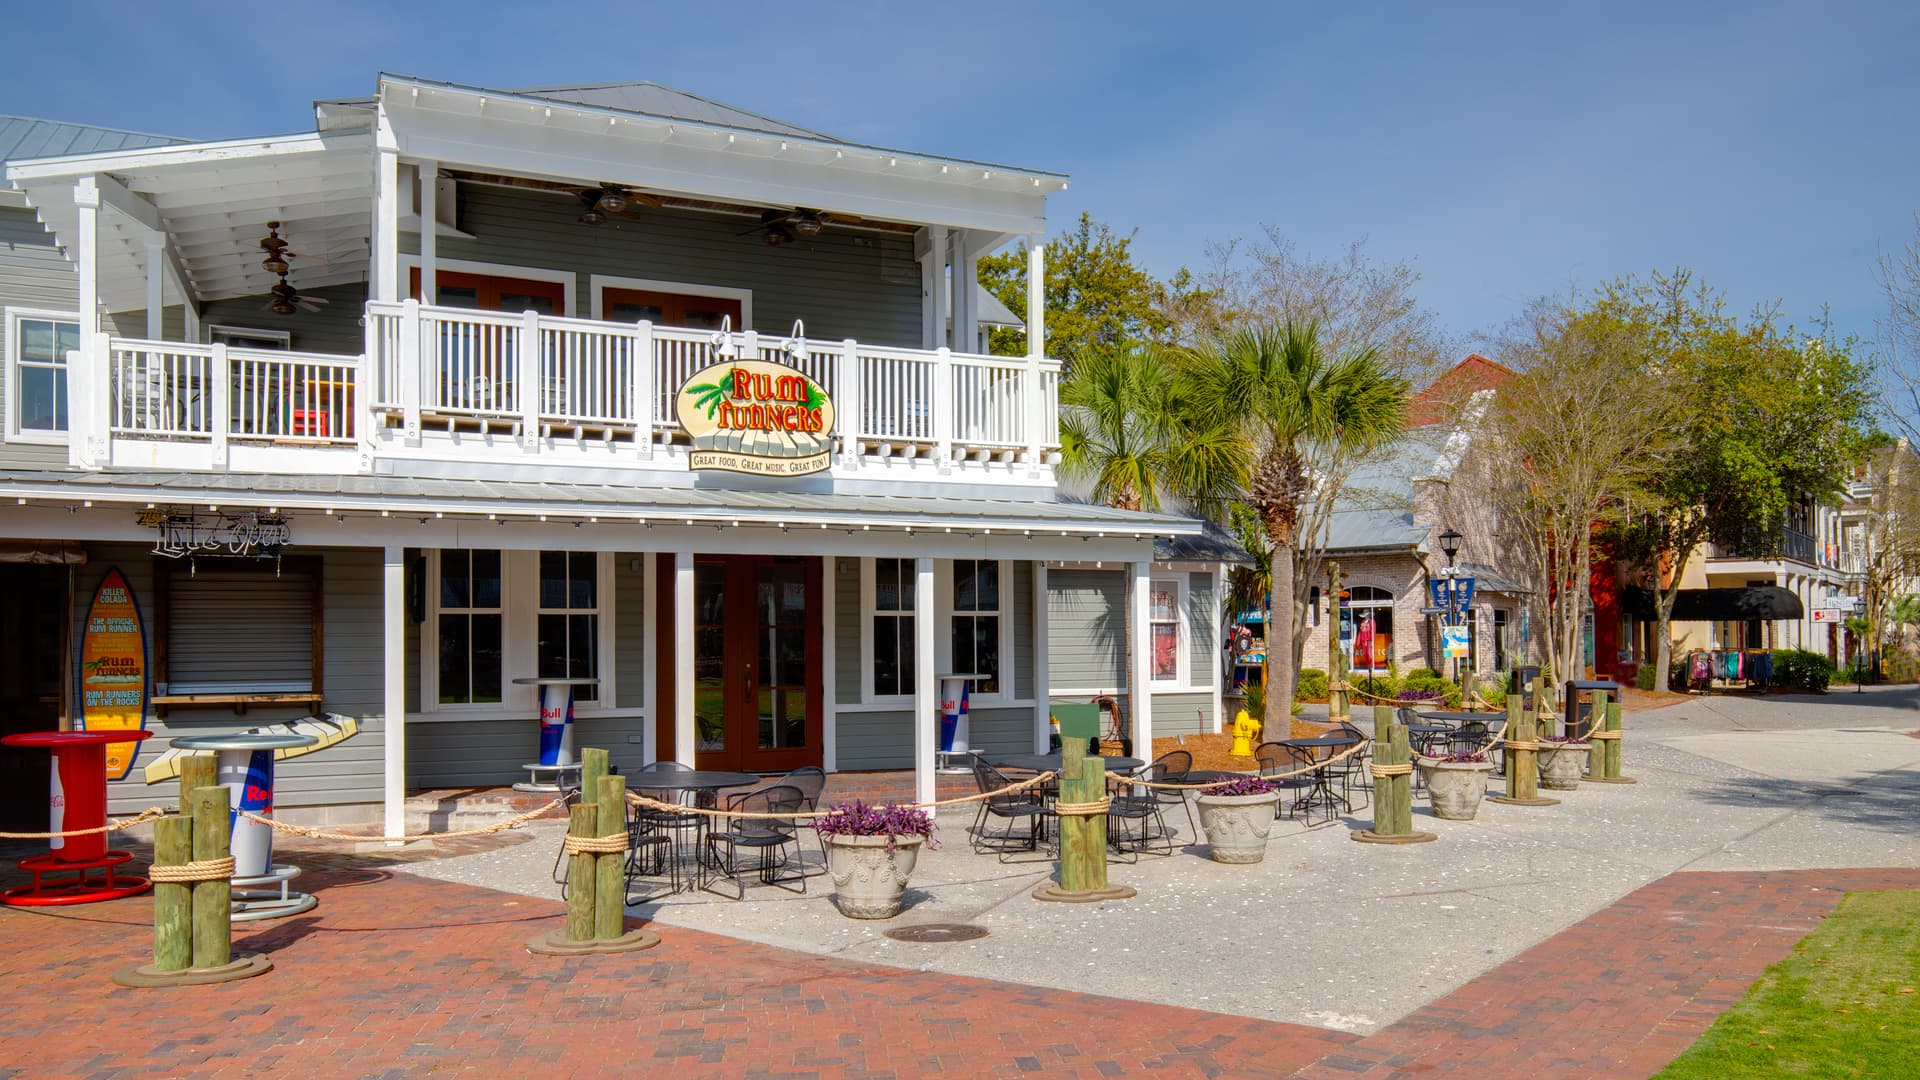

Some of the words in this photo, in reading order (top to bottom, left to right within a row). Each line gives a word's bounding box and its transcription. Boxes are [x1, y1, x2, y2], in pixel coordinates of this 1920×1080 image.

[731, 368, 809, 403] Rum
[694, 455, 716, 466] GREAT
[719, 457, 738, 468] FOOD,
[741, 458, 763, 471] GREAT
[789, 461, 810, 473] GREAT
[812, 456, 828, 469] FUN!
[102, 587, 125, 596] KILLER
[100, 595, 127, 603] COLADA
[93, 617, 105, 625] THE
[89, 624, 107, 632] RUM
[108, 624, 137, 632] RUNNER
[86, 690, 106, 699] RUM
[106, 690, 141, 699] RUNNERS
[87, 698, 98, 706] ON
[100, 698, 114, 706] THE
[116, 698, 140, 706] ROCKS
